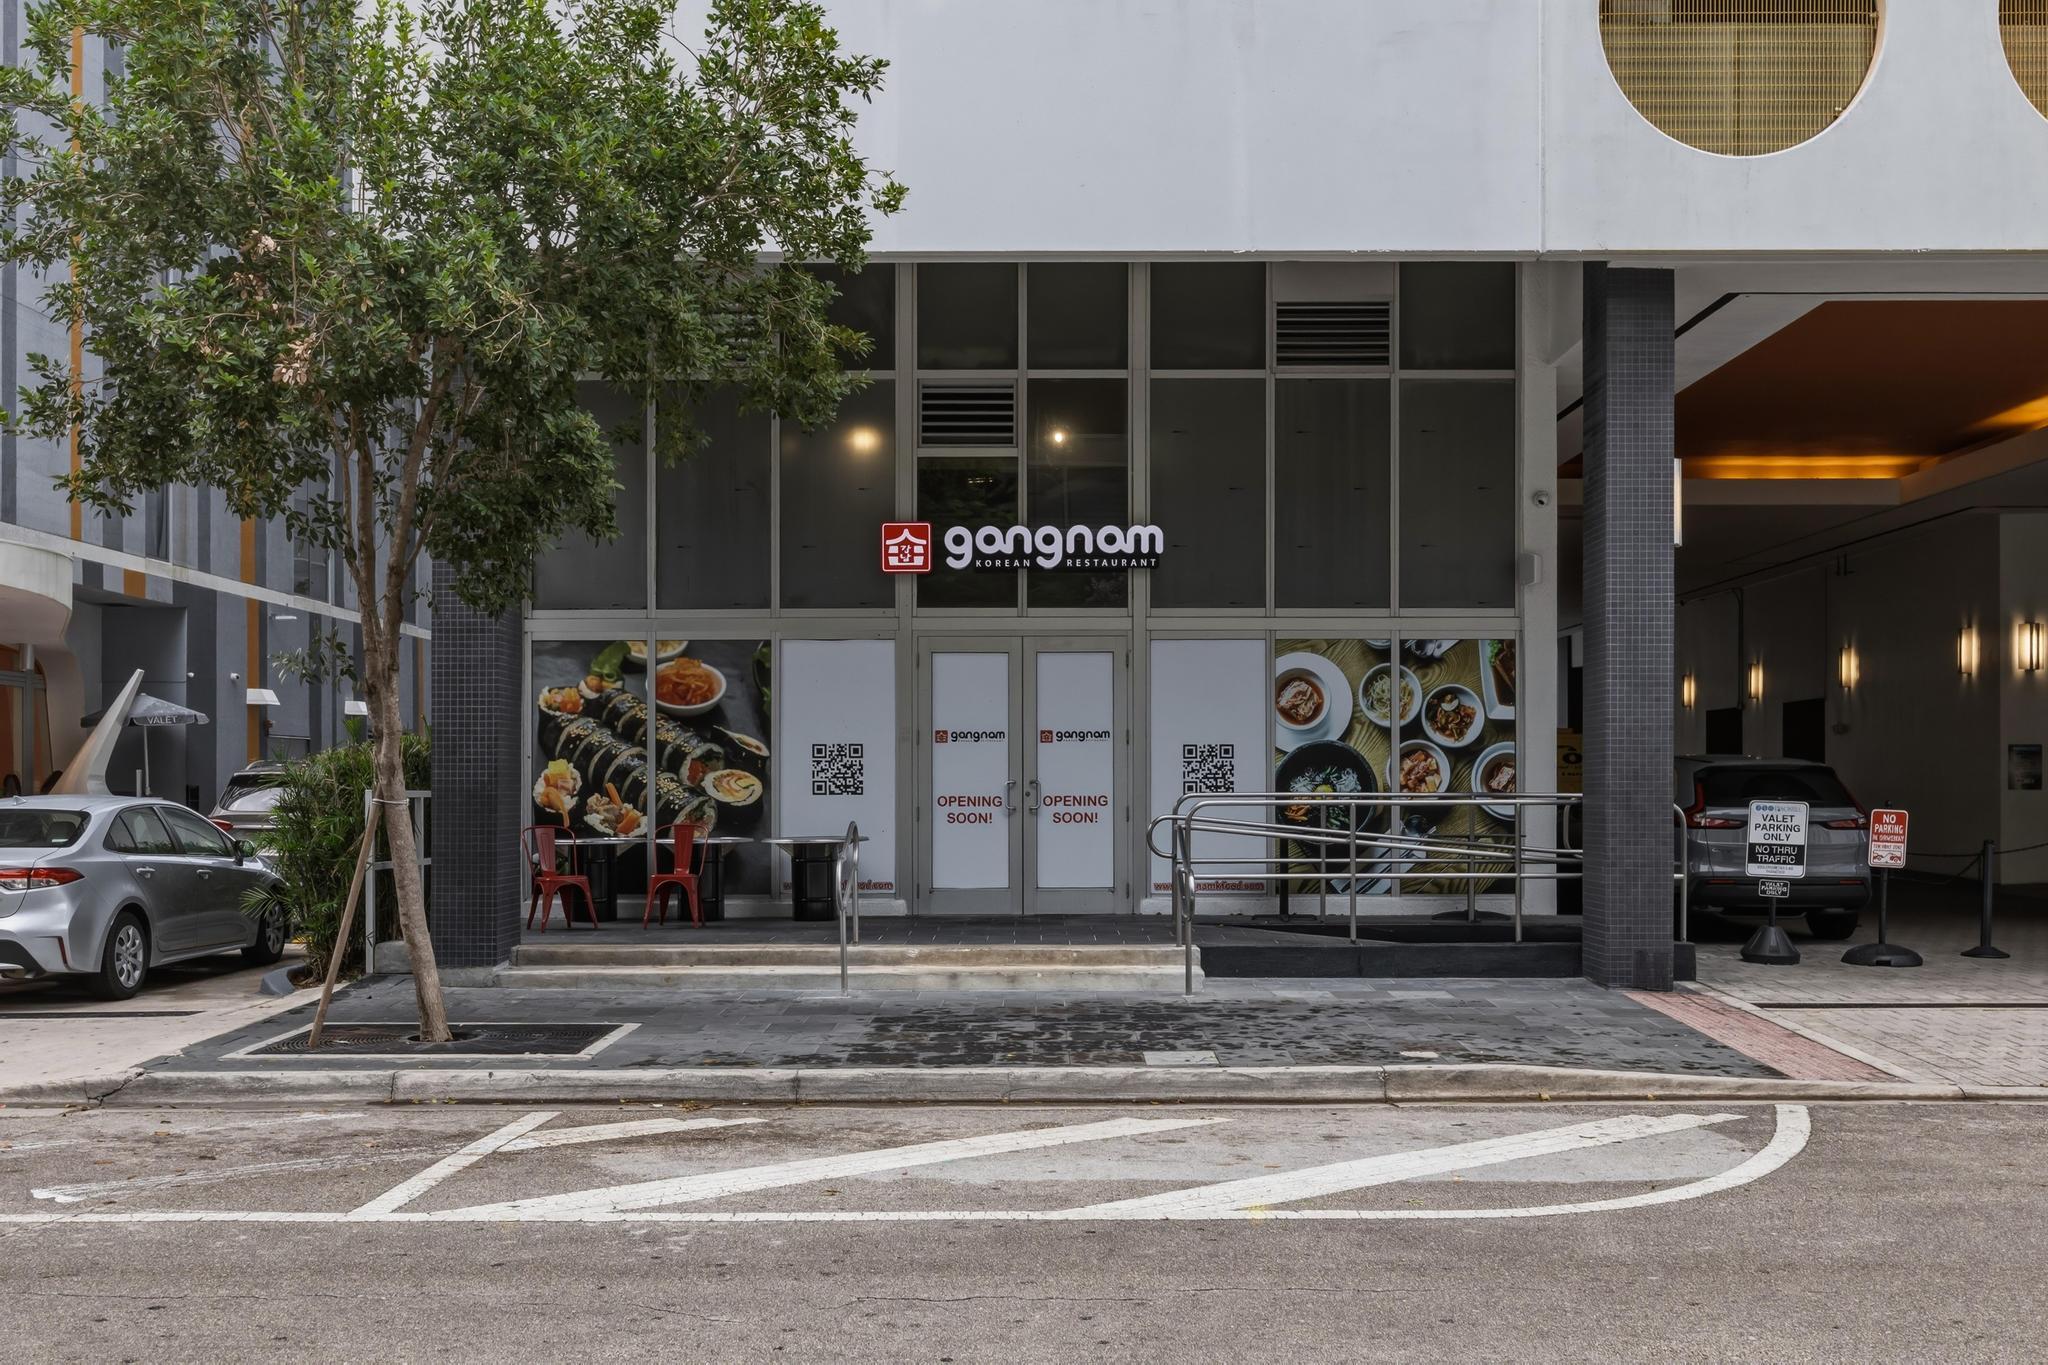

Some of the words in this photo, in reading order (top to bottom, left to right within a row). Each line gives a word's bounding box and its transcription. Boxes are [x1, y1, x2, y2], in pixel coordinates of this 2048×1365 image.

[944, 524, 1164, 570] gangnam
[975, 559, 1031, 568] KOREAN
[1066, 558, 1158, 568] RESTAURANT
[146, 715, 178, 724] VALET
[950, 731, 1006, 743] gangnam
[1055, 730, 1111, 742] gangnam
[937, 795, 1003, 807] OPENING
[1042, 795, 1109, 807] OPENING
[946, 812, 993, 824] SOON!
[1052, 812, 1099, 824] SOON!
[1761, 814, 1796, 823] VALET
[1882, 813, 1897, 824] NO
[1754, 823, 1801, 833] PARKING
[1874, 823, 1904, 834] PARKING
[1763, 832, 1791, 842] ONLY
[1755, 845, 1770, 854] NO
[1771, 845, 1798, 855] THRU
[1756, 854, 1796, 864] TRAFFIC
